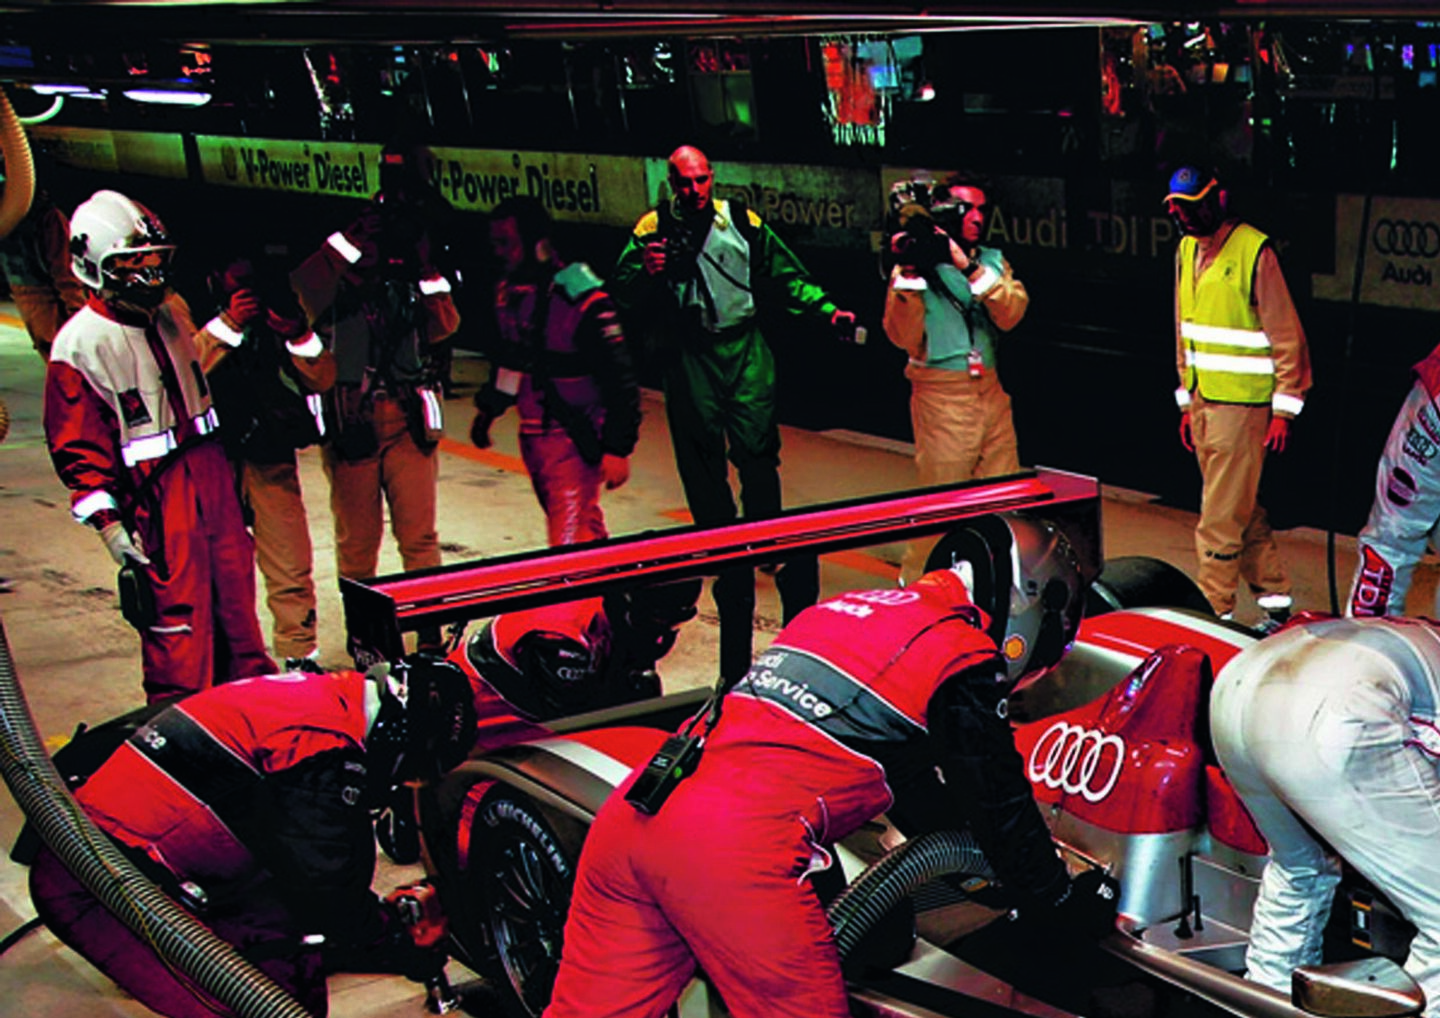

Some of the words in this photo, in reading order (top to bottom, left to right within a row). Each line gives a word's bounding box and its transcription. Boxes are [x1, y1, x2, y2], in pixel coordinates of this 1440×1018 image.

[242, 147, 310, 181] V-Power
[313, 152, 368, 193] Diesel
[526, 163, 600, 213] Diesel
[763, 187, 855, 229] Power
[986, 207, 1068, 250] Audi
[1382, 262, 1433, 287] Audi
[1354, 565, 1385, 615] TDI
[756, 669, 833, 718] Service
